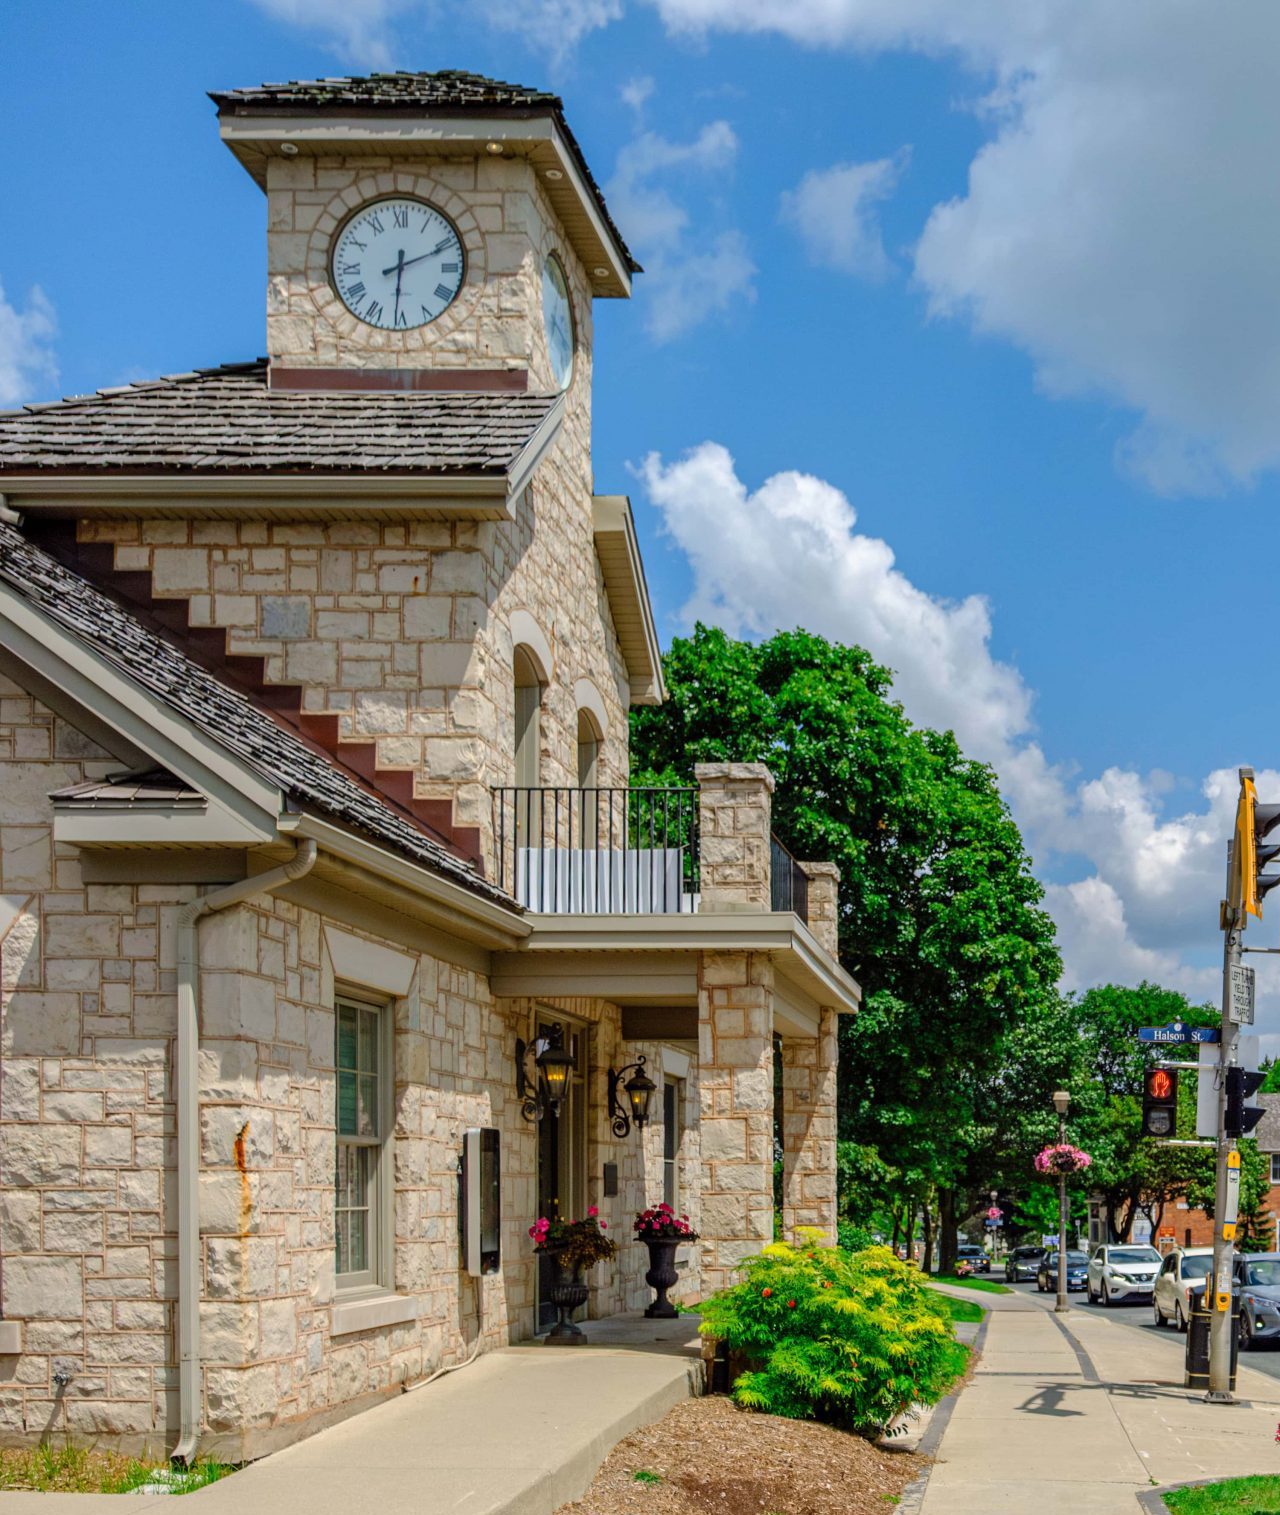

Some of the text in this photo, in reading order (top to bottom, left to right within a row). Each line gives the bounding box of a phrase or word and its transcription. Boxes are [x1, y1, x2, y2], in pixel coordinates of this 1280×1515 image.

[365, 215, 385, 237] XI
[393, 207, 408, 228] XII
[349, 237, 367, 252] X
[1153, 1030, 1185, 1041] Halson
